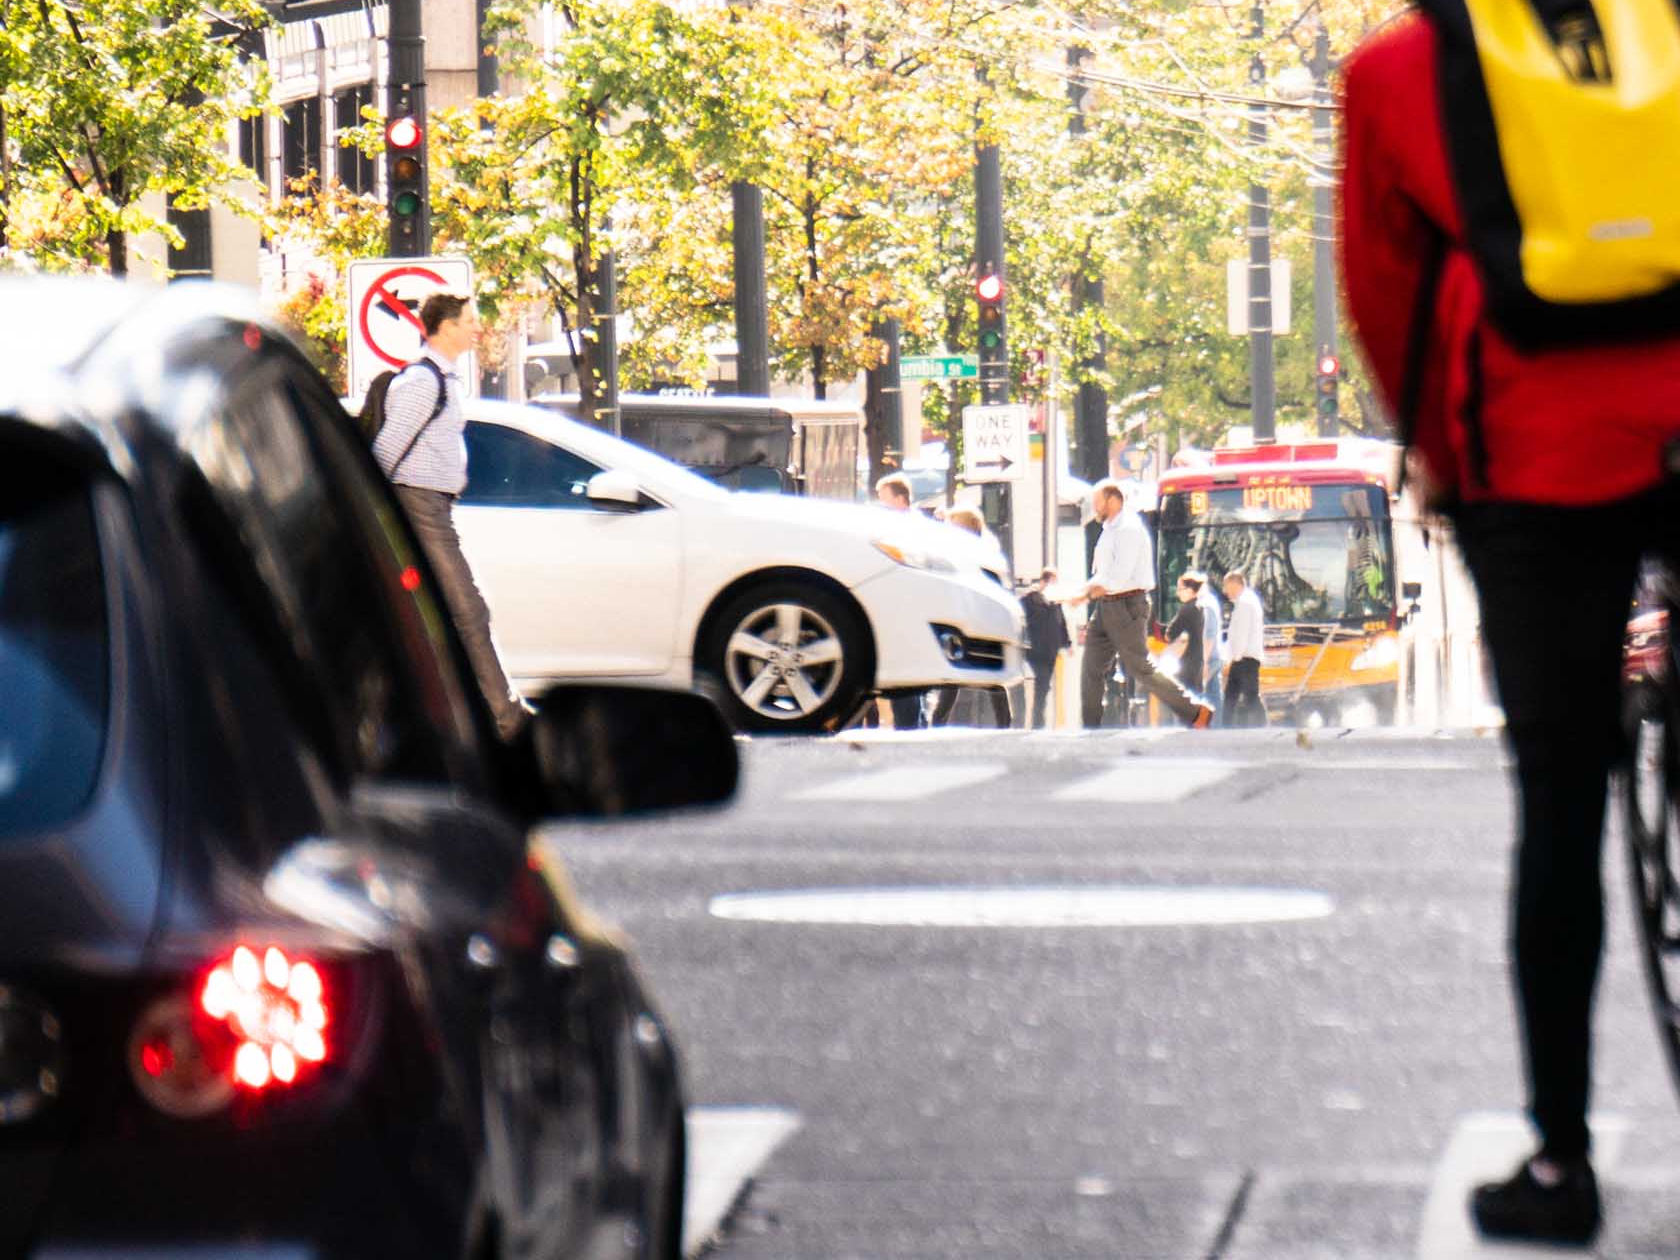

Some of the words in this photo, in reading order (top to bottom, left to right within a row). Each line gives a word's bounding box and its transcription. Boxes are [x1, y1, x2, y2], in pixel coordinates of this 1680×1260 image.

[900, 359, 945, 376] umbia
[975, 414, 1012, 429] ONE
[975, 434, 1014, 449] WAY
[1243, 486, 1313, 511] UPTOWN
